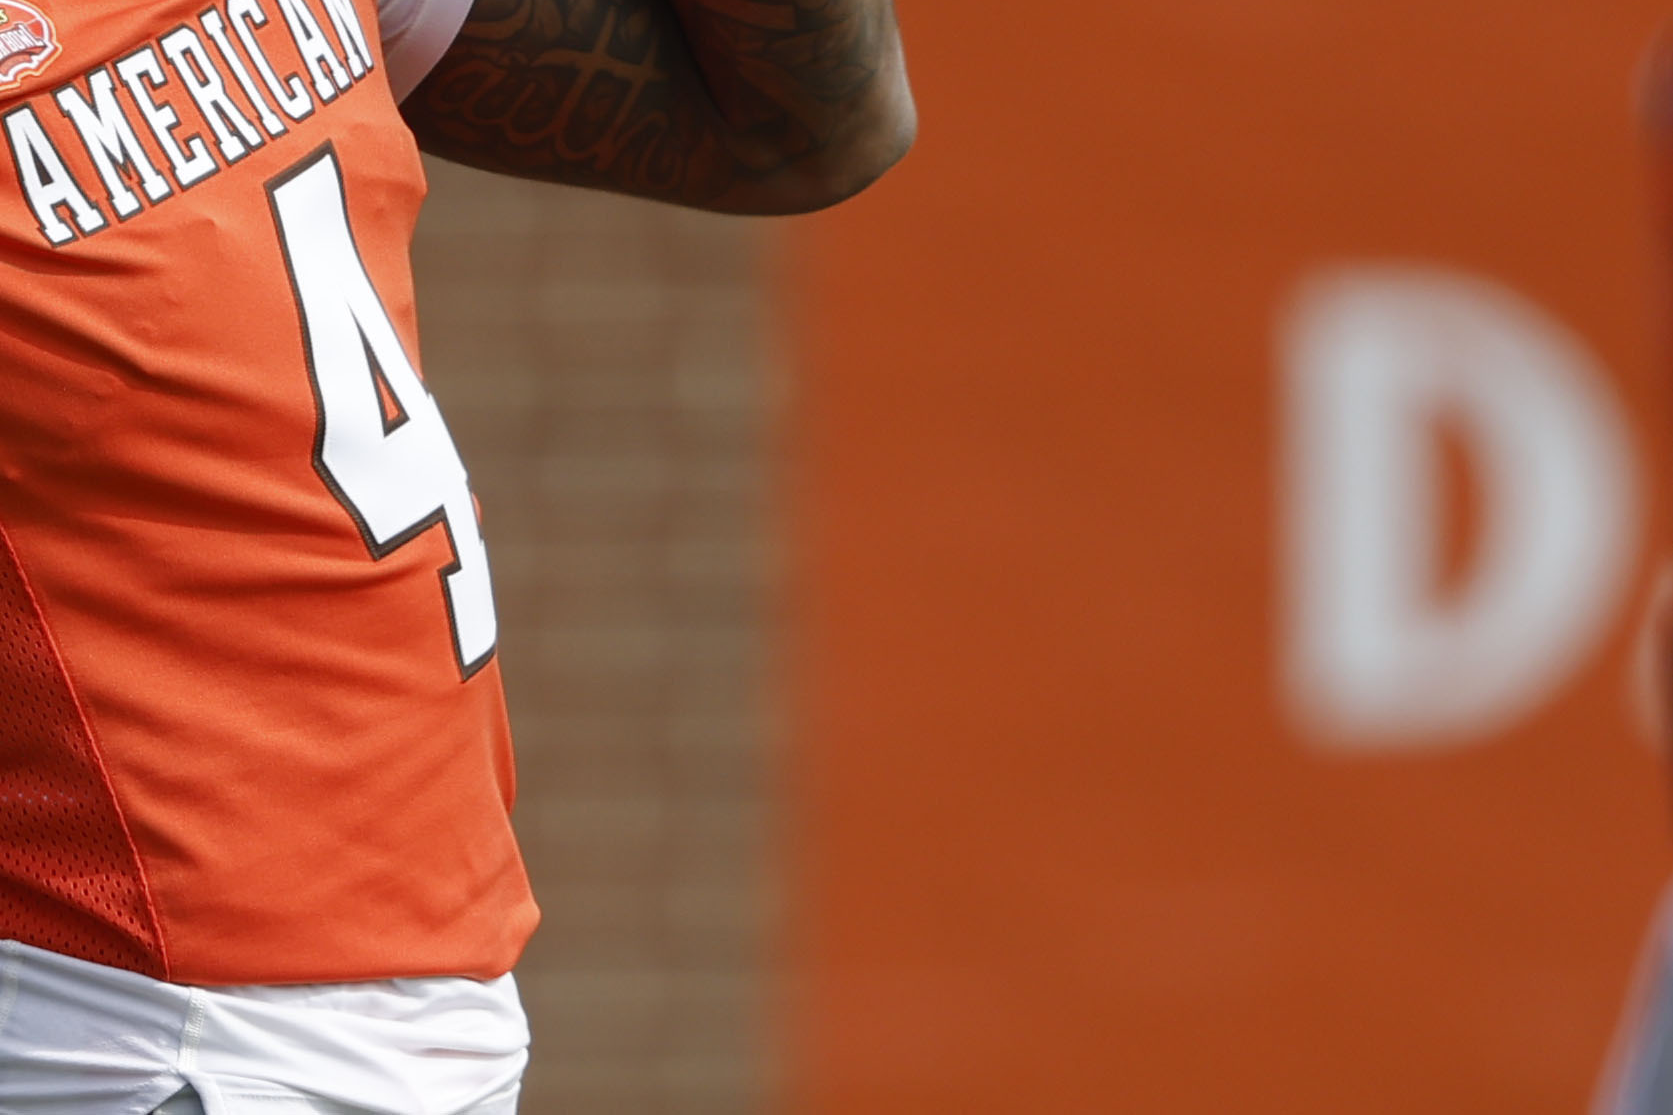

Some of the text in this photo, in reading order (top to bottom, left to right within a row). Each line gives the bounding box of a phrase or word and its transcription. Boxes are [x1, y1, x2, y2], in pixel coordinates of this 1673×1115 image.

[0, 23, 46, 52] BOWL
[264, 139, 499, 684] 4
[1273, 260, 1673, 763] D
